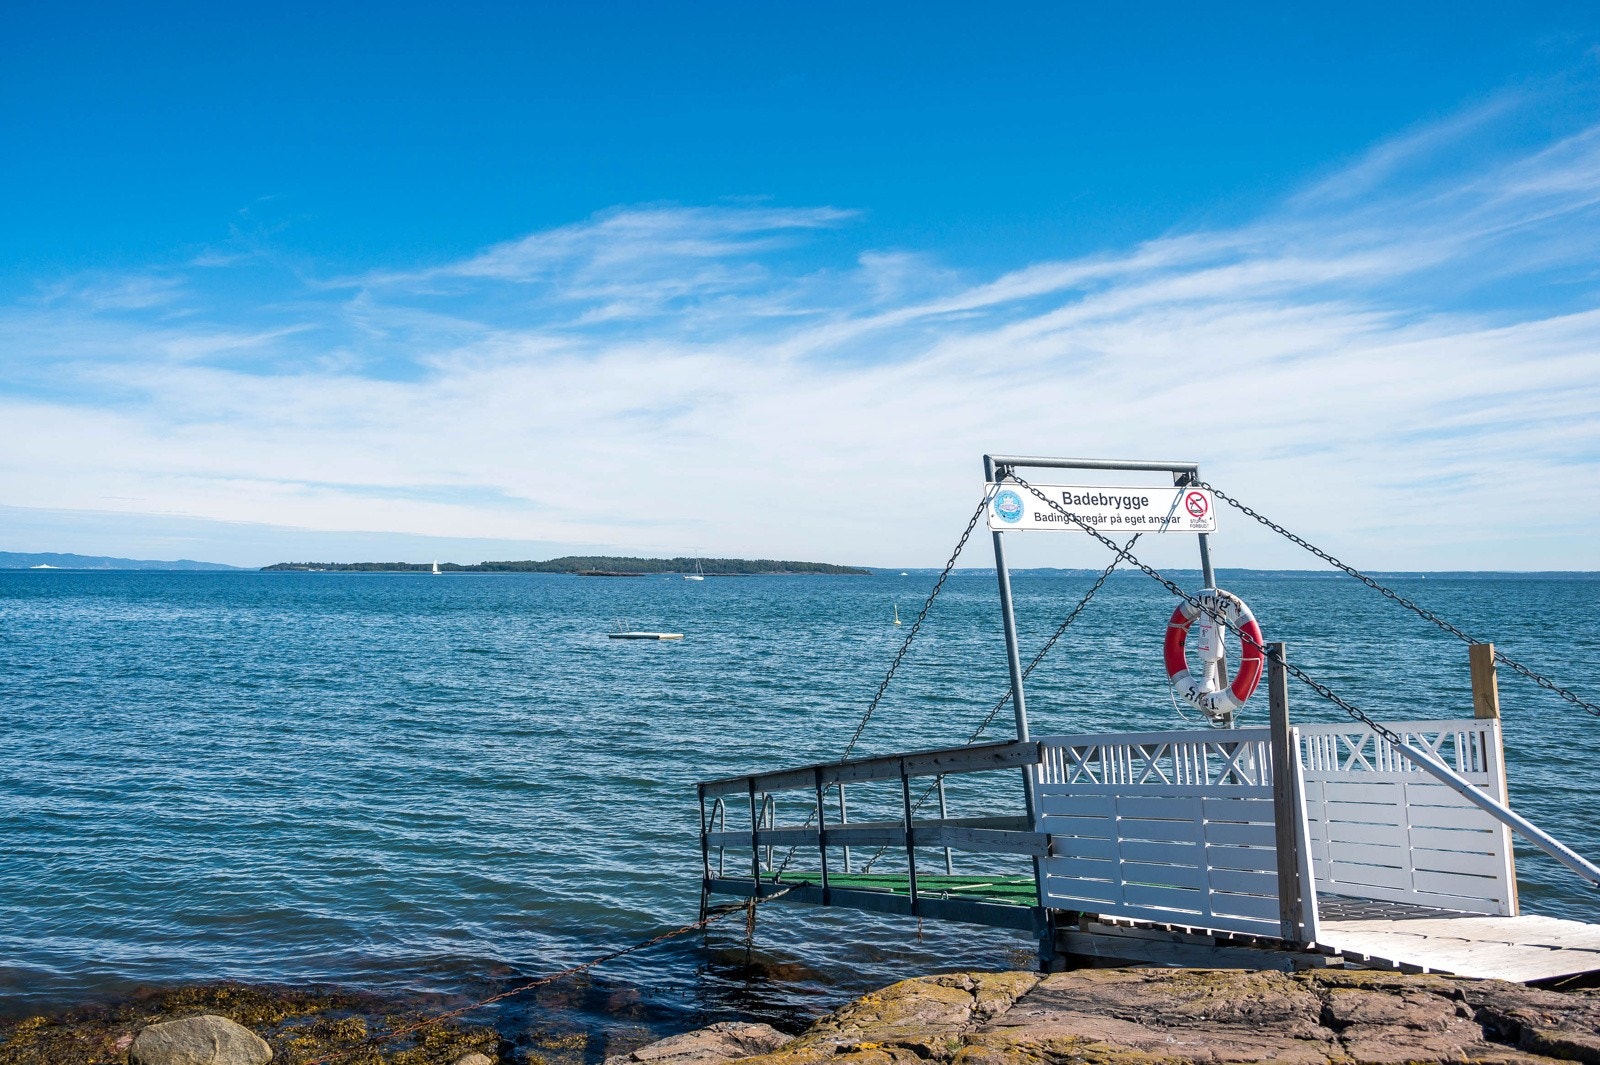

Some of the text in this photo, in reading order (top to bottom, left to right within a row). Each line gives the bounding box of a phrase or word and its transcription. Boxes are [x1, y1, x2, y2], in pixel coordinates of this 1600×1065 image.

[1062, 491, 1149, 510] Badebrygge
[1034, 512, 1181, 525] Bading oregår på eget ansvar
